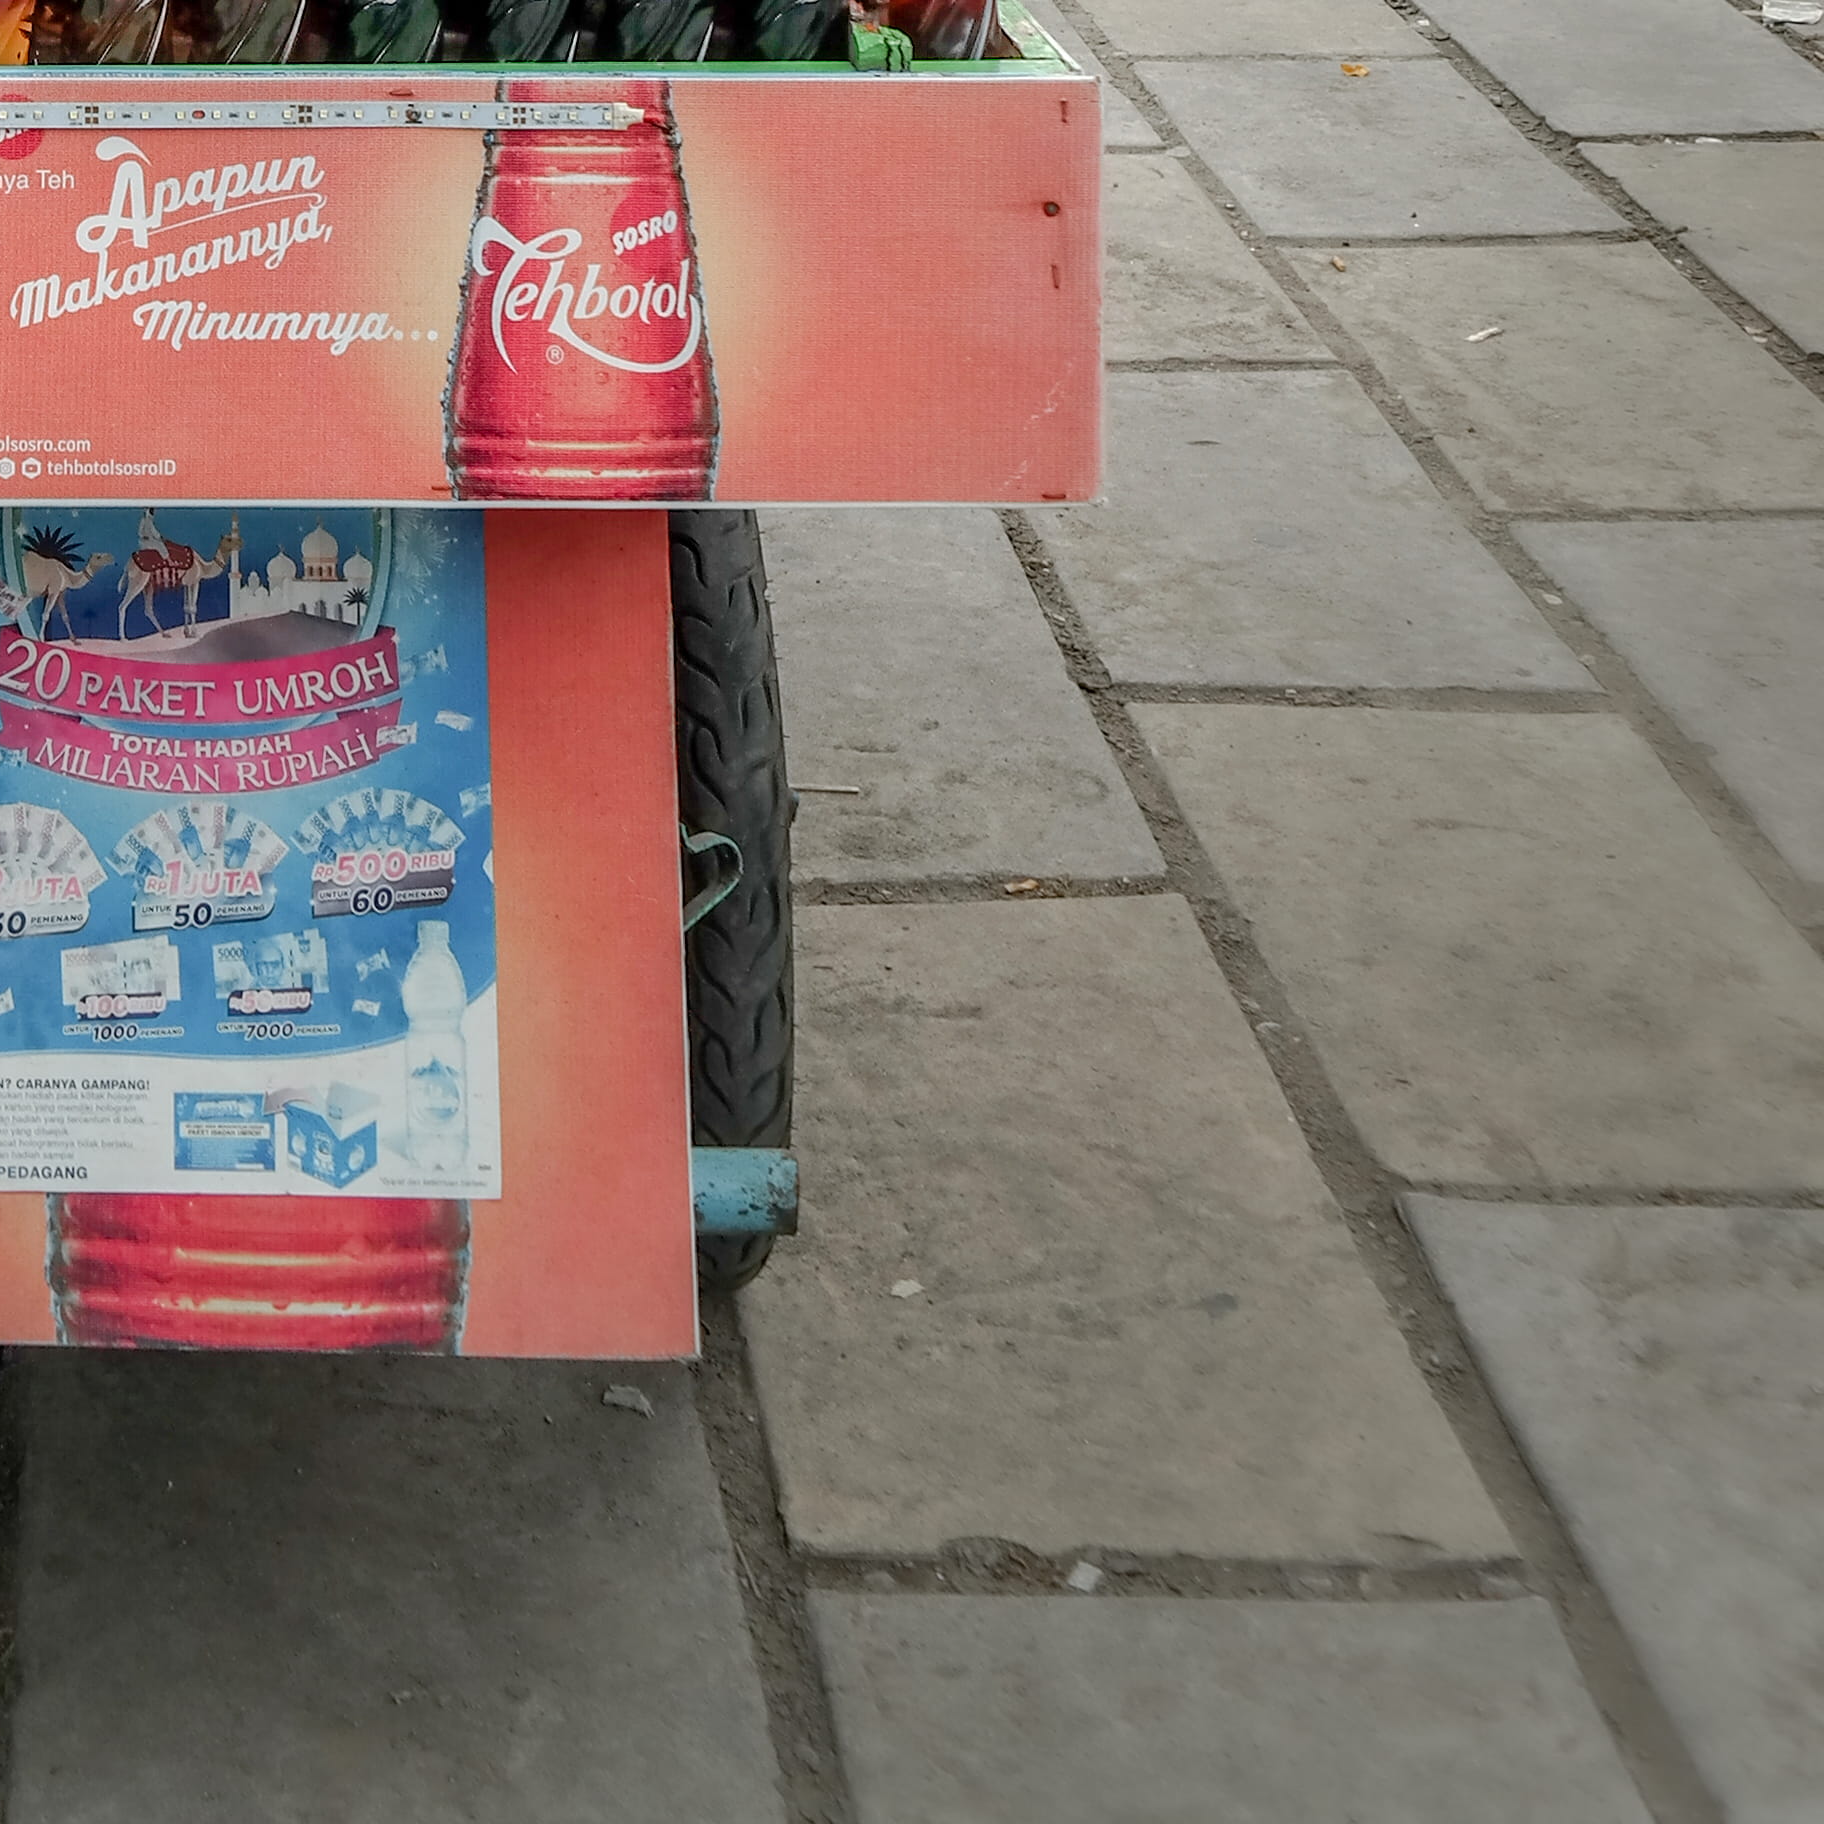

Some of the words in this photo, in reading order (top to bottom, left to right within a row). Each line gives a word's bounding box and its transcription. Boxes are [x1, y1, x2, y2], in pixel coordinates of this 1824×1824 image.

[36, 170, 75, 190] Teh
[76, 152, 325, 253] Apapun
[612, 209, 677, 256] SOSRO
[10, 205, 333, 328] Makanannya,
[474, 216, 702, 375] Tehbotol
[133, 300, 439, 356] Minumnya...
[47, 459, 177, 477] tehbotolsosroID
[77, 671, 215, 718] PAKET
[235, 651, 394, 715] UMROH
[109, 734, 189, 758] TOTAL
[194, 733, 293, 758] HADIAH
[32, 737, 221, 792] MILIARAN
[237, 734, 373, 790] RUPIAH
[410, 851, 454, 870] RIBU
[183, 869, 262, 897] JUTA
[319, 890, 349, 901] UNTUK
[352, 887, 393, 914] 60
[396, 888, 447, 901] PEMENANG
[30, 913, 84, 925] PEMENANG
[142, 904, 172, 914] UNTUK
[173, 902, 212, 928] 50
[216, 903, 266, 915] PEMENANG
[93, 1024, 137, 1040] 1000
[247, 1022, 293, 1039] 7000
[16, 1079, 77, 1090] CARANYA
[81, 1080, 150, 1091] GAMPANG!
